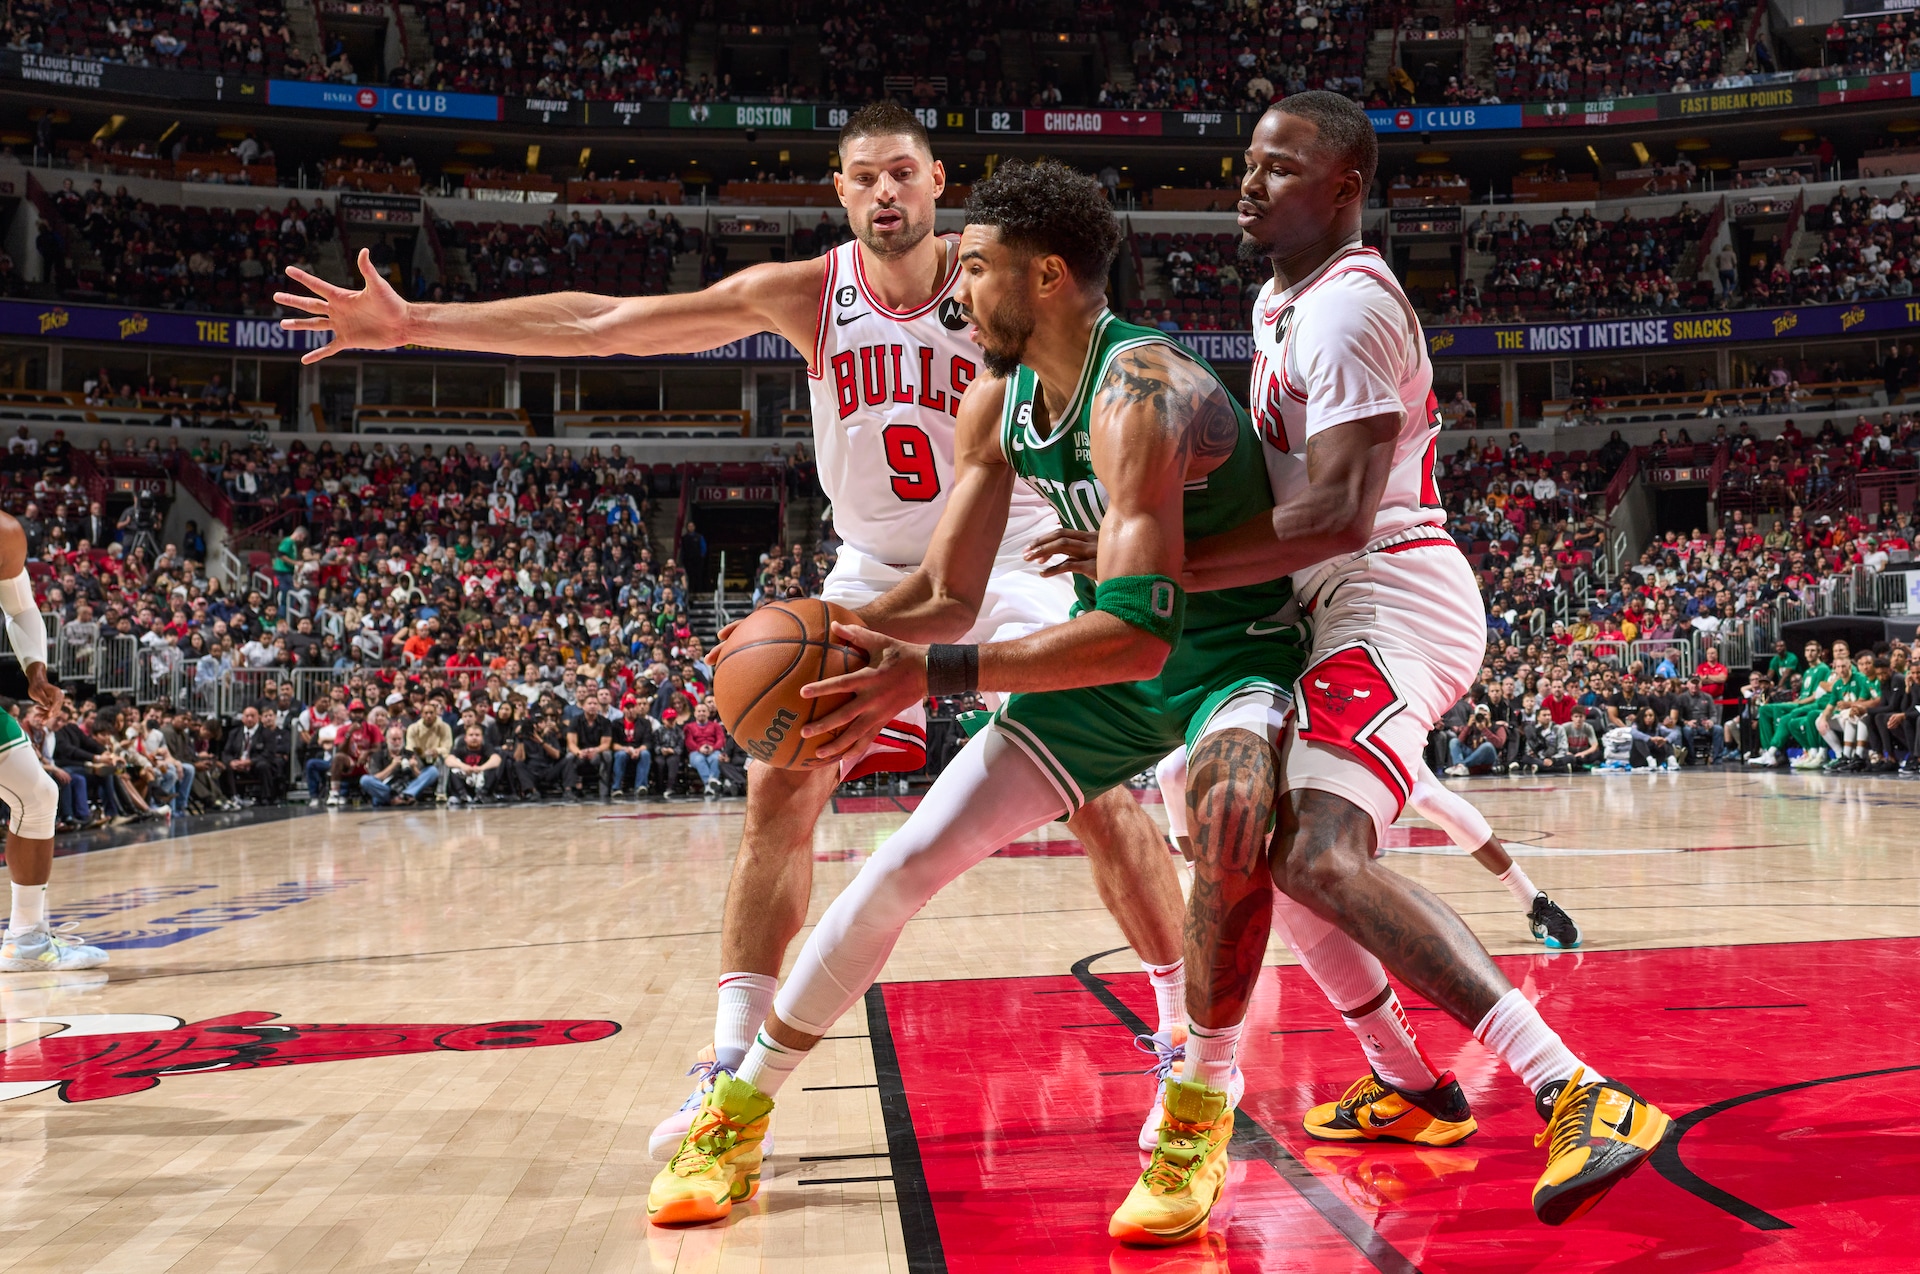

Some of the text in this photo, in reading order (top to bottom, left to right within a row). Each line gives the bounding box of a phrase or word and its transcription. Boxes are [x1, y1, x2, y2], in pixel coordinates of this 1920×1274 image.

[22, 54, 104, 76] ST. LOUIS BLUES
[22, 67, 100, 88] WINNIPEG JETS
[323, 92, 447, 112] BMO CLUB
[526, 99, 568, 112] TIMEOUTS
[613, 102, 641, 114] FOULS
[1584, 101, 1615, 113] CELTICS
[1681, 90, 1793, 113] FAST BREAK POINTS
[622, 113, 631, 125] 2
[736, 107, 791, 126] BOSTON
[828, 109, 848, 127] 68
[991, 112, 1011, 130] 82
[1044, 113, 1102, 132] CHICAGO
[1182, 113, 1221, 125] TIMEOUTS
[1370, 110, 1477, 127] MO CLUB
[1585, 113, 1609, 125] BULLS
[1198, 124, 1206, 136] 3
[841, 287, 854, 305] 6
[38, 309, 69, 334] Takis
[117, 315, 148, 340] Takis
[1771, 312, 1798, 336] Takis
[1840, 306, 1865, 331] Takis
[196, 320, 230, 343] THE
[236, 320, 295, 349] MOST
[1429, 331, 1454, 355] Takis
[1495, 318, 1732, 351] THE MOST INTENSE SNACKS
[830, 343, 976, 421] BULLS
[1016, 403, 1031, 425] 6
[881, 424, 941, 503] 9
[749, 487, 767, 500] 117
[1151, 580, 1175, 618] 0
